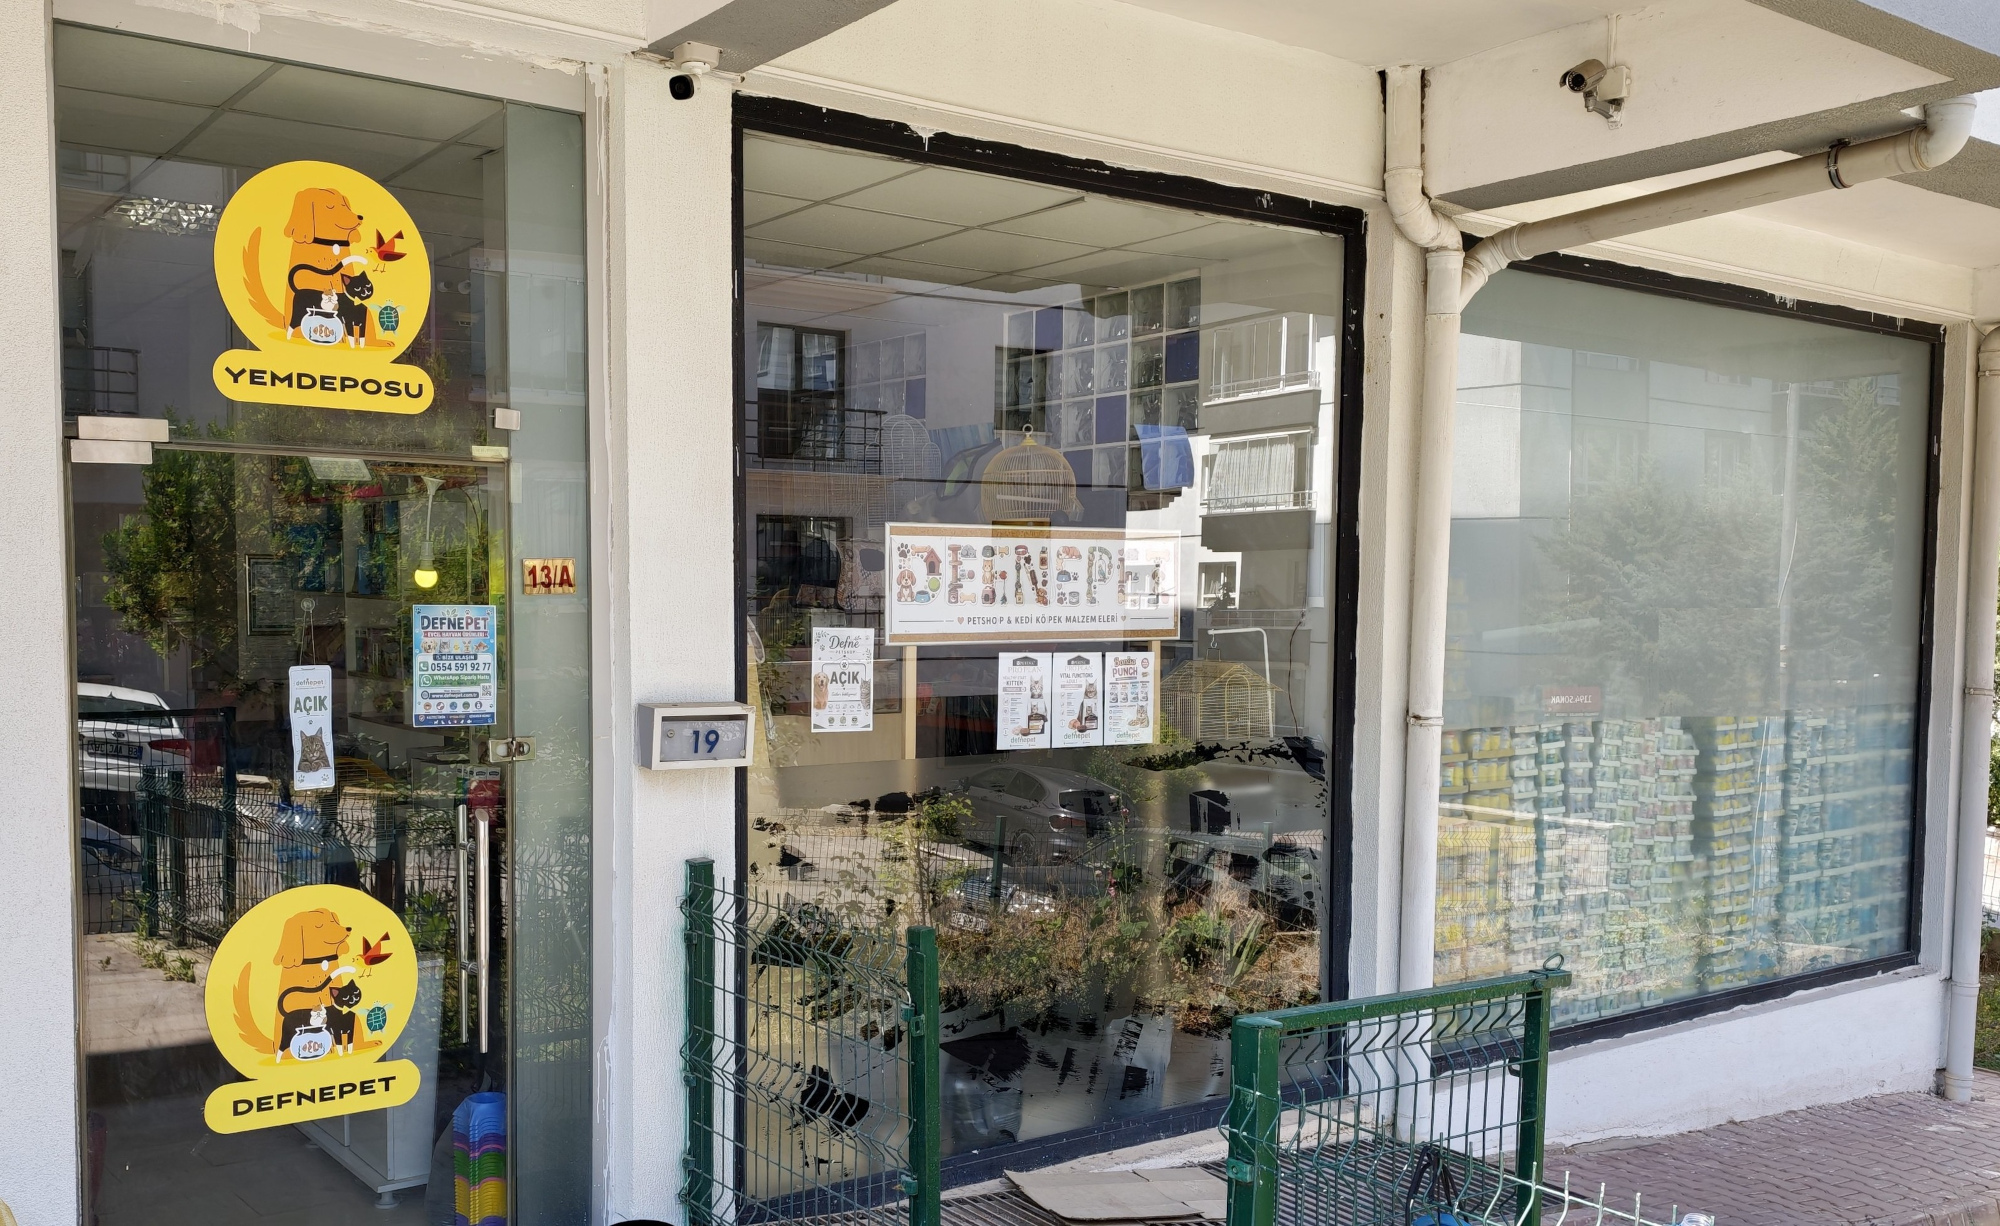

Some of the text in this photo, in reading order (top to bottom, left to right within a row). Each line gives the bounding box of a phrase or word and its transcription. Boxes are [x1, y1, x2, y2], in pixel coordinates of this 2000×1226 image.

[224, 366, 423, 399] YEMDEPOSU
[528, 565, 573, 588] 13/A
[420, 615, 489, 630] DEFNEPET
[1006, 616, 1012, 625] &
[1014, 614, 1033, 624] KEDİ
[829, 635, 860, 649] Defne
[430, 662, 491, 671] 0554 591 92 77
[1112, 667, 1138, 678] PUNCH
[829, 671, 860, 687] AÇIK
[293, 695, 328, 715] AÇIK
[692, 729, 720, 754] 19
[233, 1076, 396, 1116] DEFNEPET
